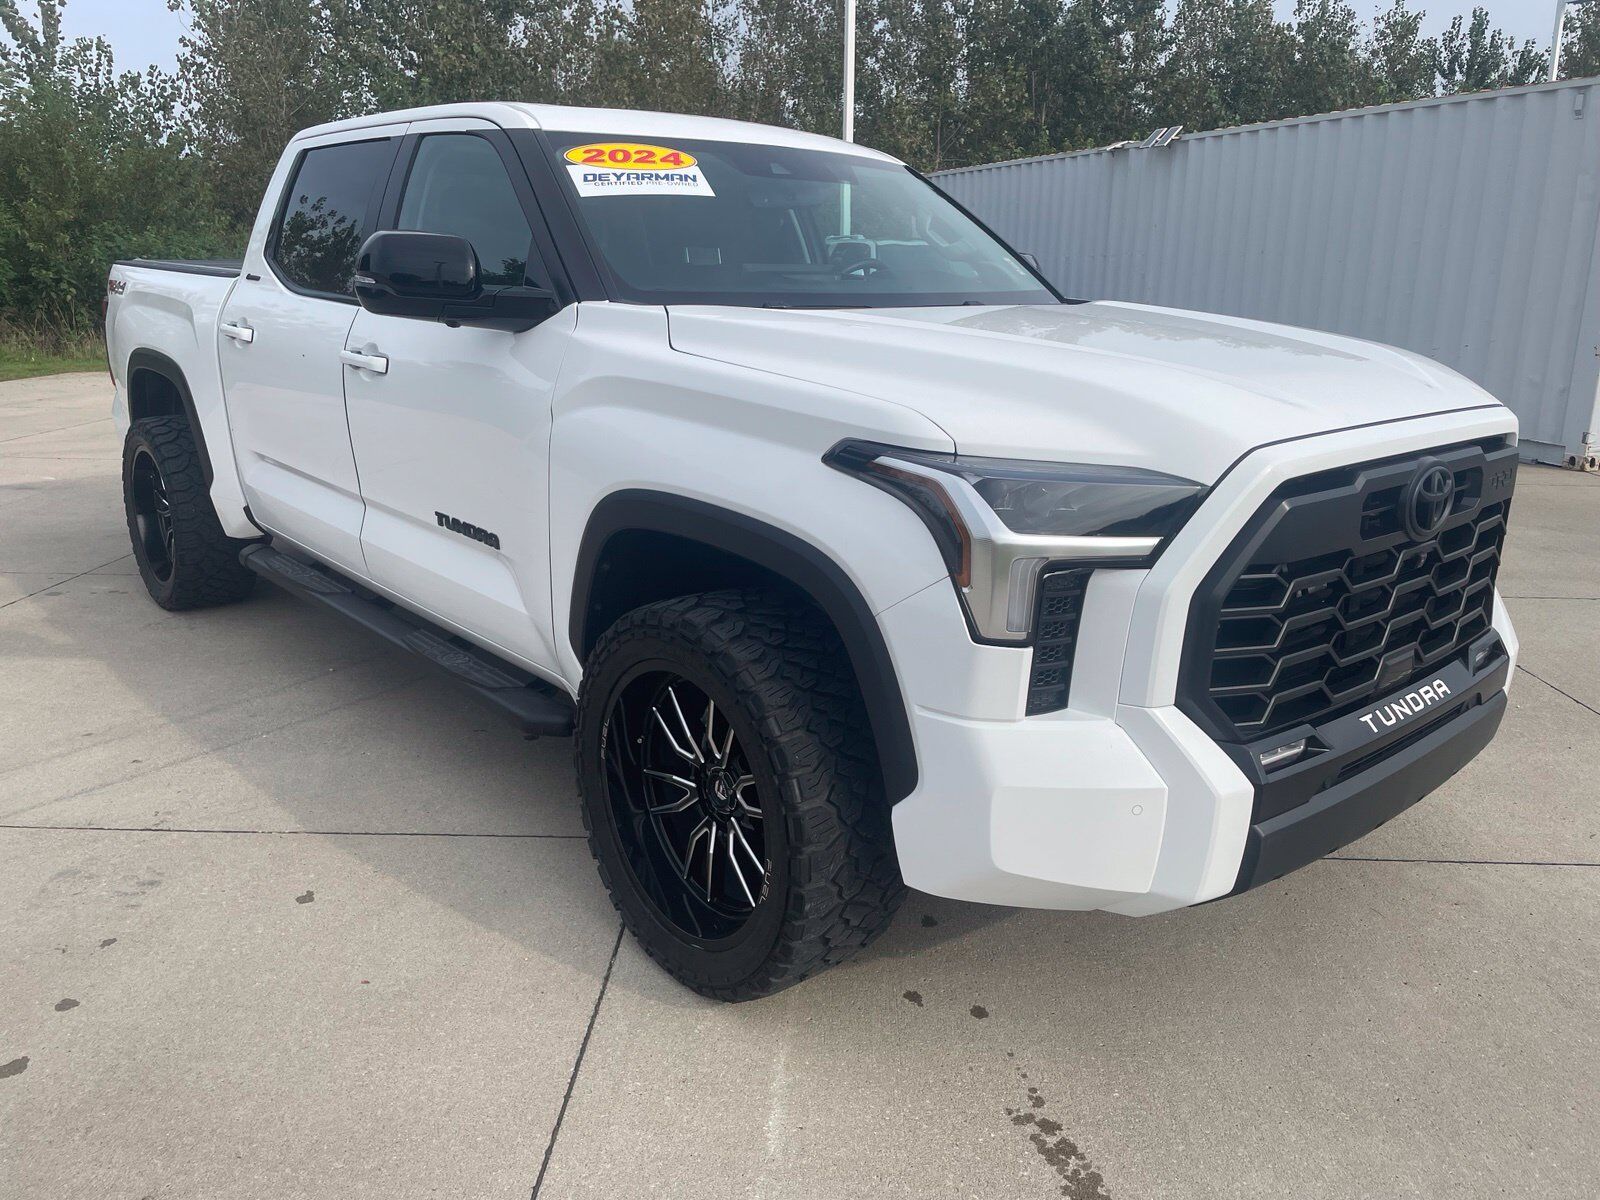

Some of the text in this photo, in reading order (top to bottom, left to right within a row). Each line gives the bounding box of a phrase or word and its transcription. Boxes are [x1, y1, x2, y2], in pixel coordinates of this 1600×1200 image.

[582, 148, 684, 166] 2024
[583, 172, 697, 183] DEYARMAN
[434, 510, 501, 551] TUNDRA
[1359, 678, 1452, 733] TUNDRA
[758, 858, 773, 905] FUEL
